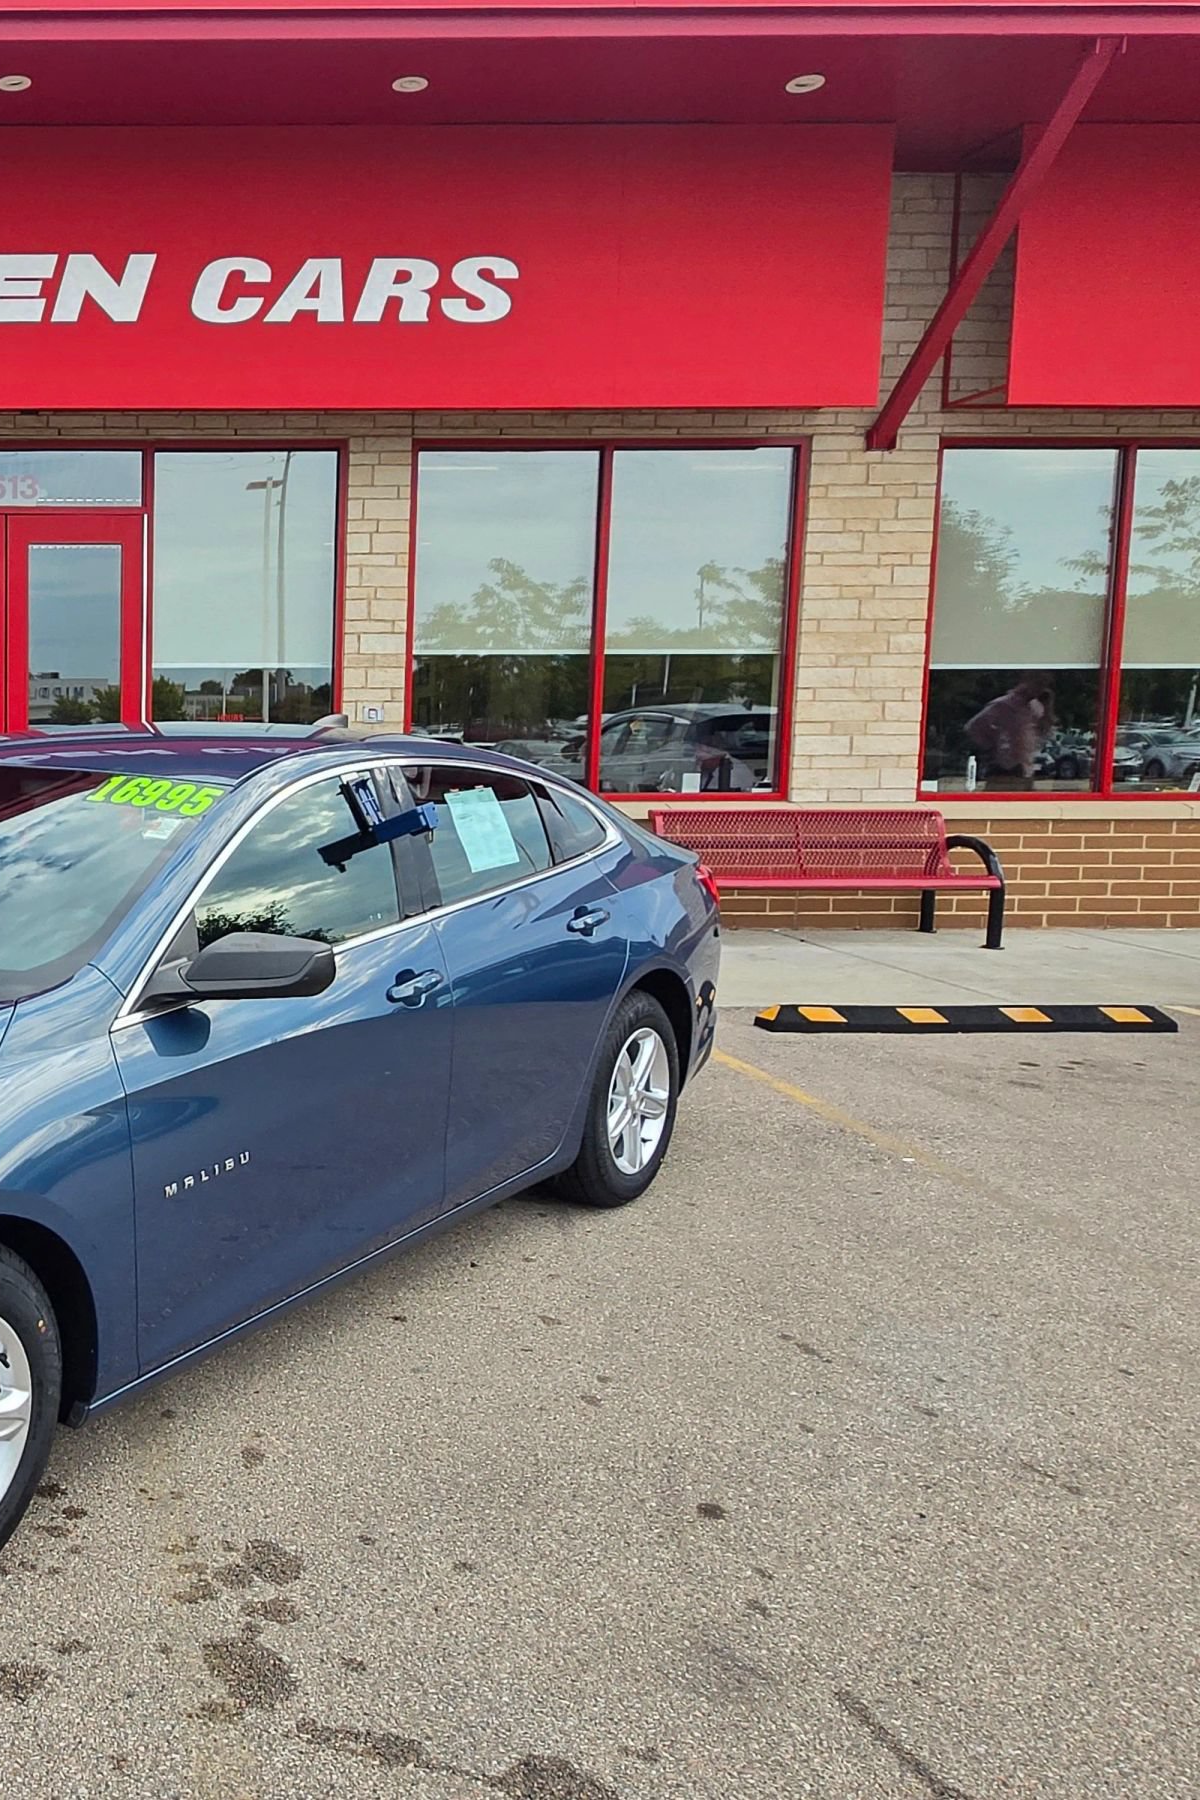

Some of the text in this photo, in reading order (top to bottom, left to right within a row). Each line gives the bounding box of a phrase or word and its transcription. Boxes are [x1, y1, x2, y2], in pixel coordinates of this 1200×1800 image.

[190, 255, 519, 323] CARS
[86, 775, 225, 816] 16995
[164, 1151, 250, 1198] MALIBU
